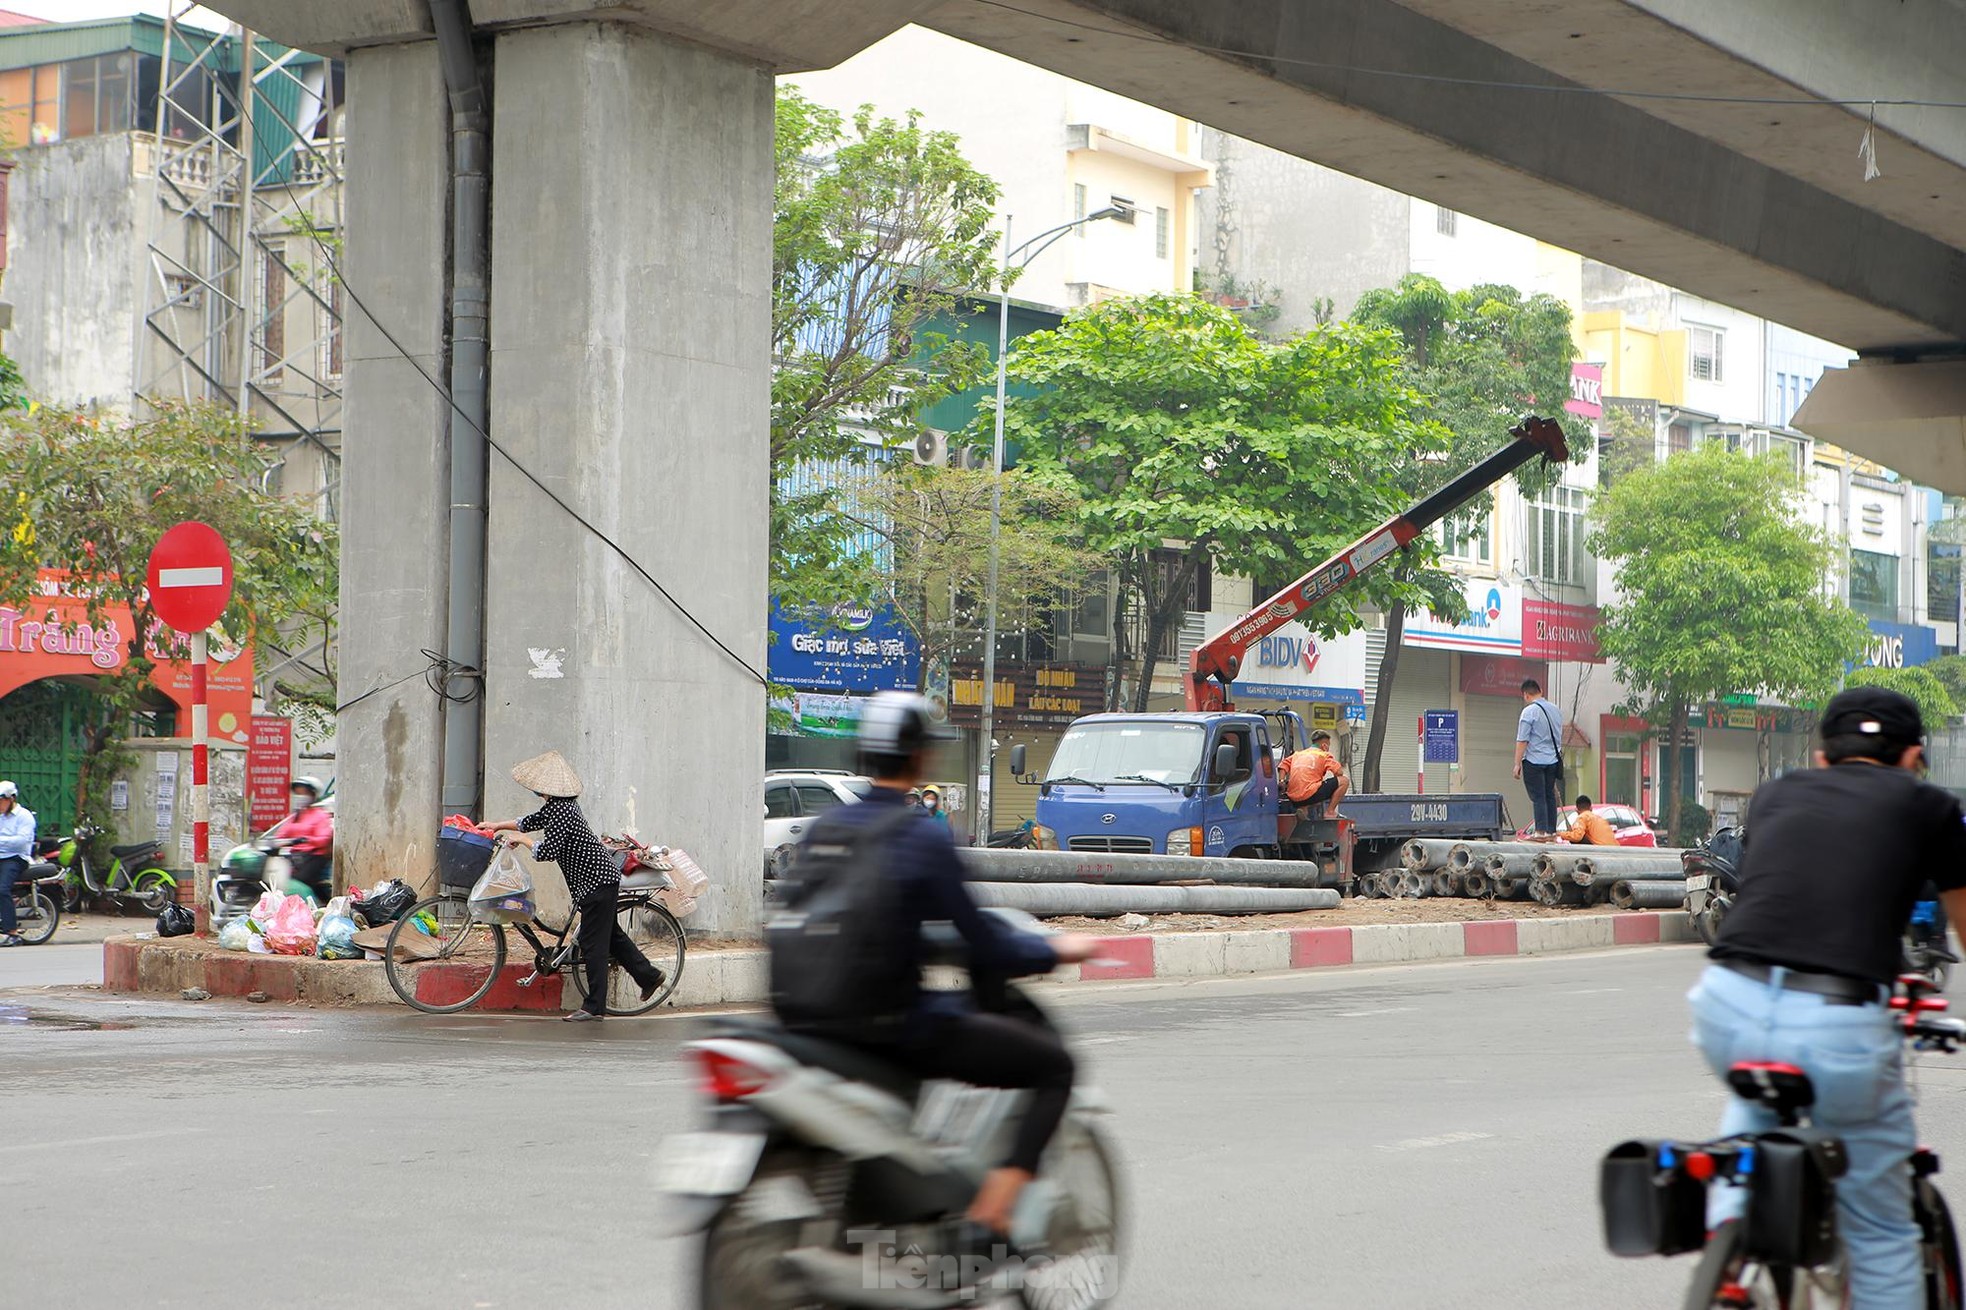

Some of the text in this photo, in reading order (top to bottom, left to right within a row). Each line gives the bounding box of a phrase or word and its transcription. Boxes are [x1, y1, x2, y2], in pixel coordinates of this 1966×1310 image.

[1545, 624, 1595, 646] AGRIBANK
[1260, 636, 1302, 667] BIDV
[1438, 717, 1444, 728] P
